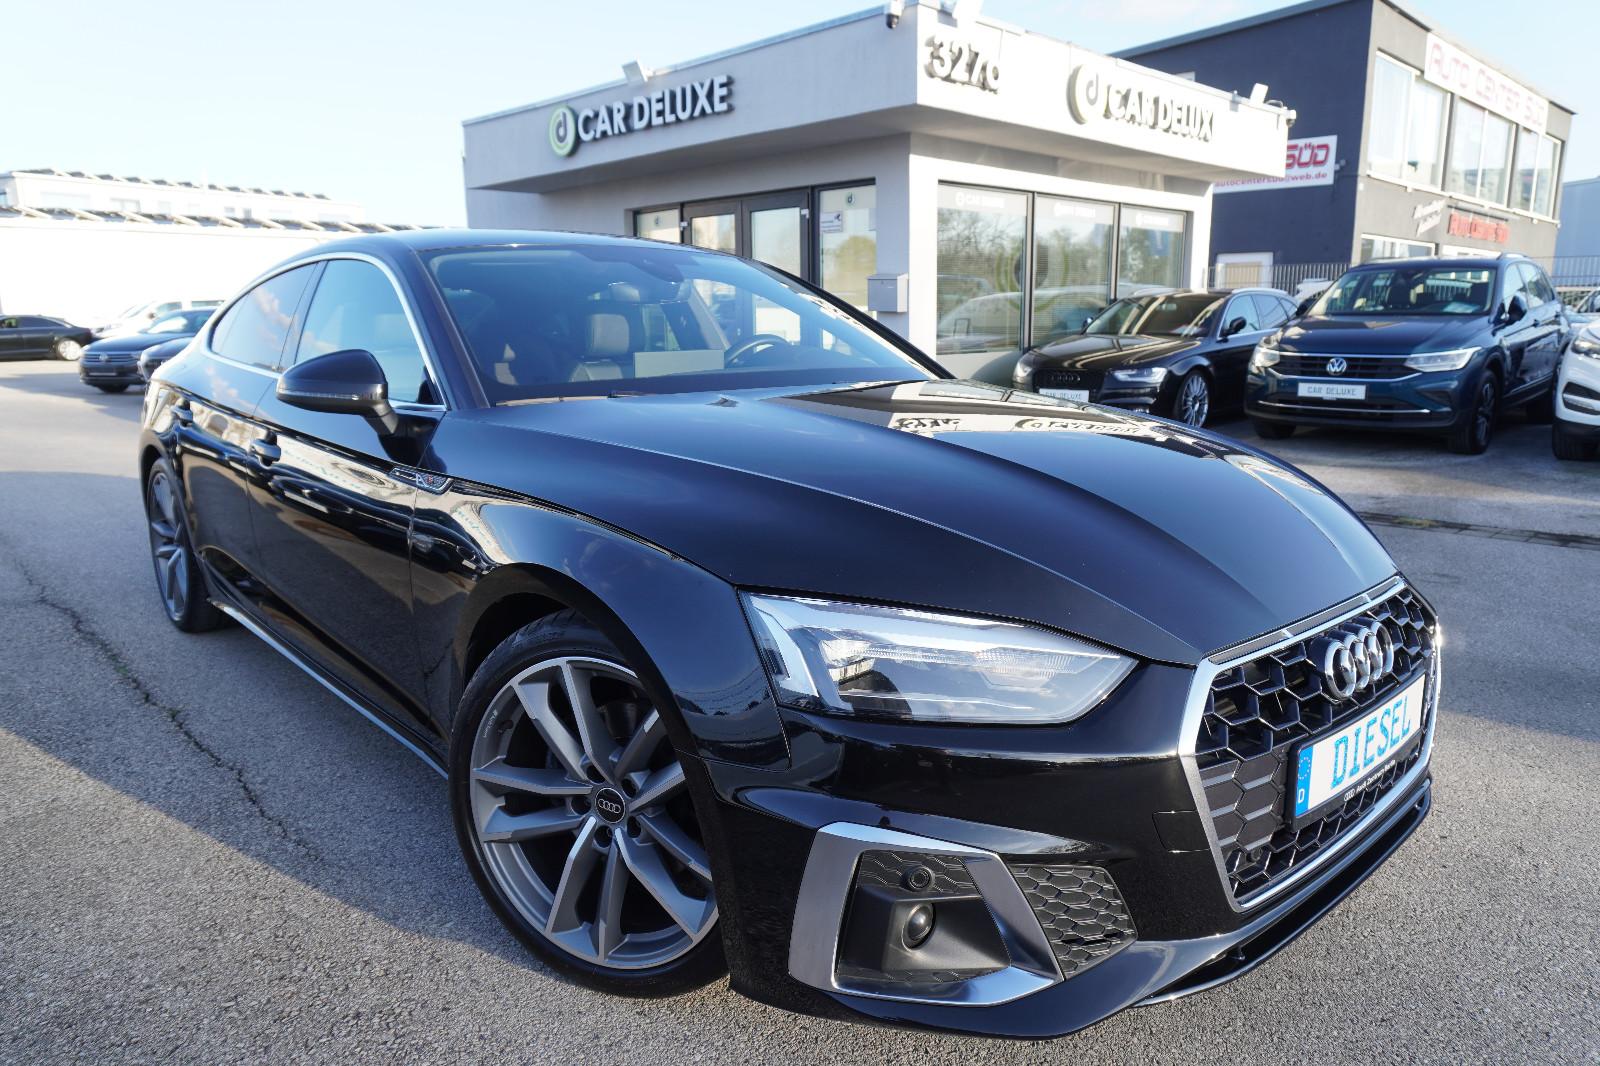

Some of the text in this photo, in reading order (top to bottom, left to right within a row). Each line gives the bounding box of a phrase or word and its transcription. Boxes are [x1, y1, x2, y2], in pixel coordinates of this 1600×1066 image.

[1429, 43, 1470, 90] AUTO
[577, 74, 731, 142] CAR DELUXE
[1285, 142, 1330, 169] SÜD
[1307, 386, 1357, 396] CAR DELUXE
[1330, 695, 1411, 790] DIESEL
[1297, 788, 1305, 804] D
